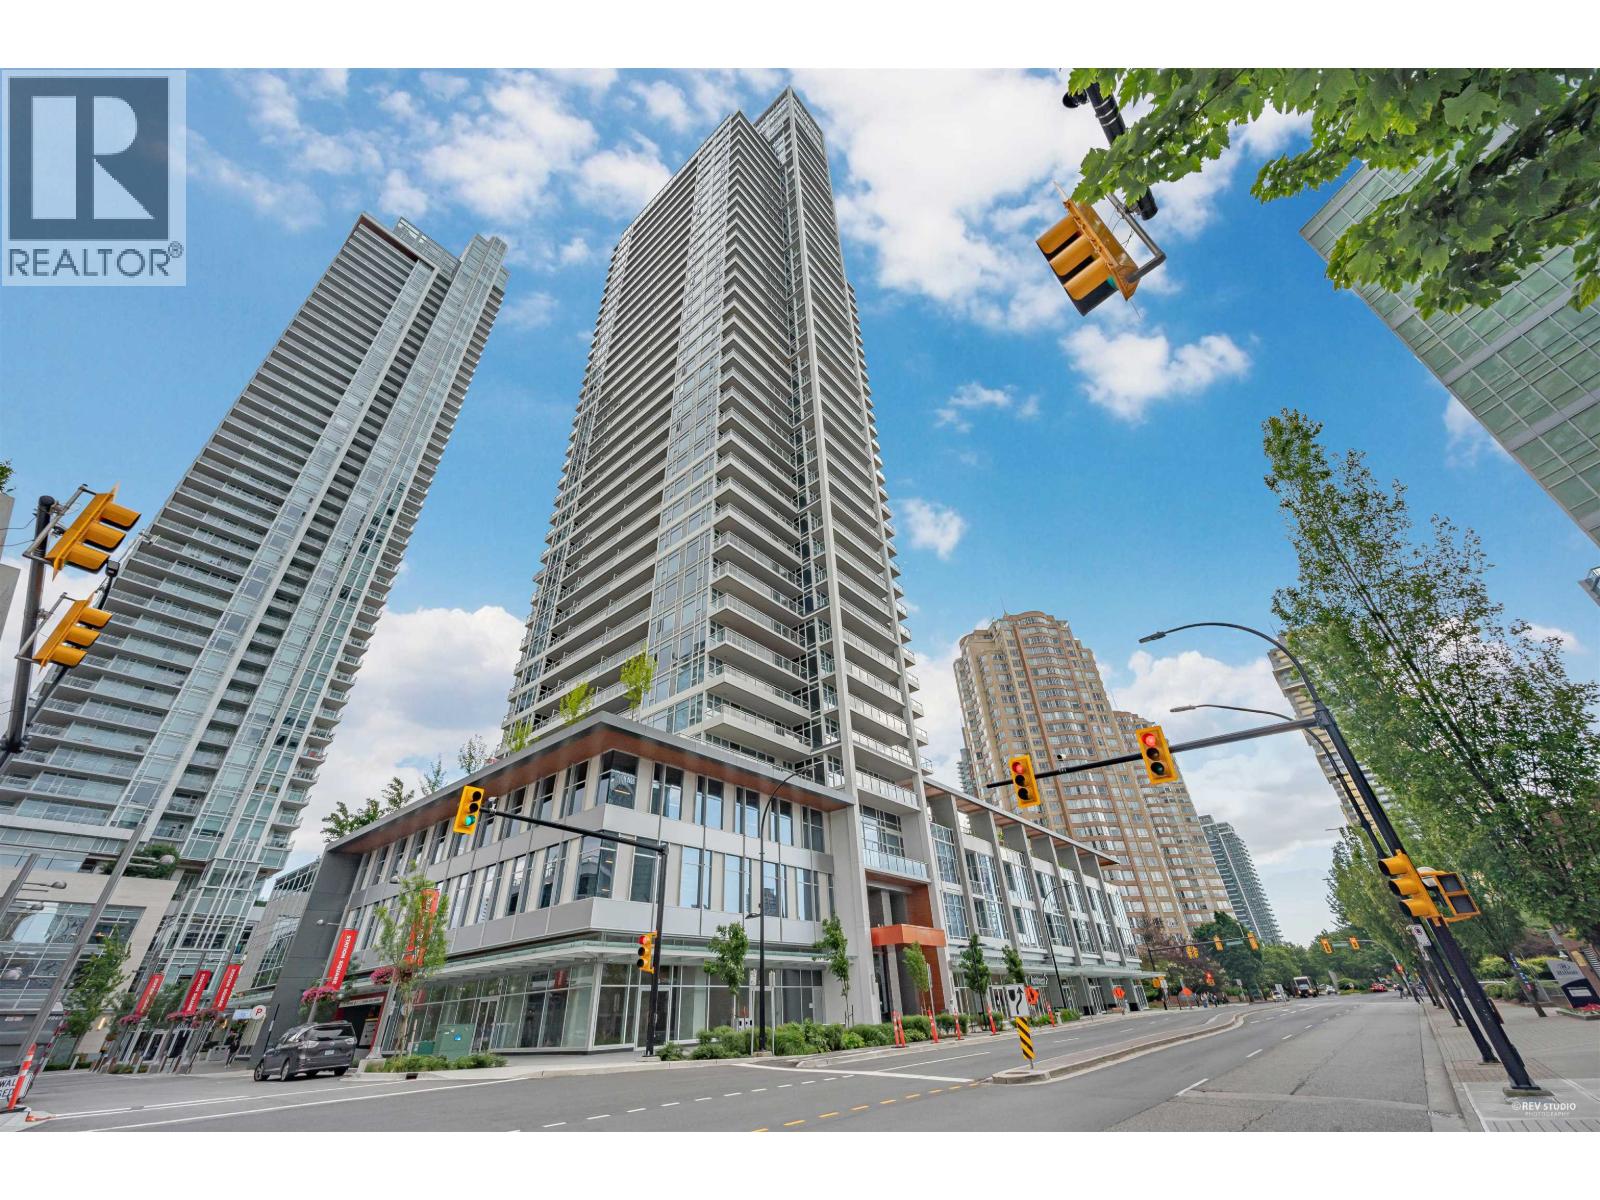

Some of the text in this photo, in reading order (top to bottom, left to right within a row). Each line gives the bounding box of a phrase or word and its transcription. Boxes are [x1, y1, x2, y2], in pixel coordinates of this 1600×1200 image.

[332, 935, 351, 984] STATION SQUARE
[256, 1008, 263, 1016] P
